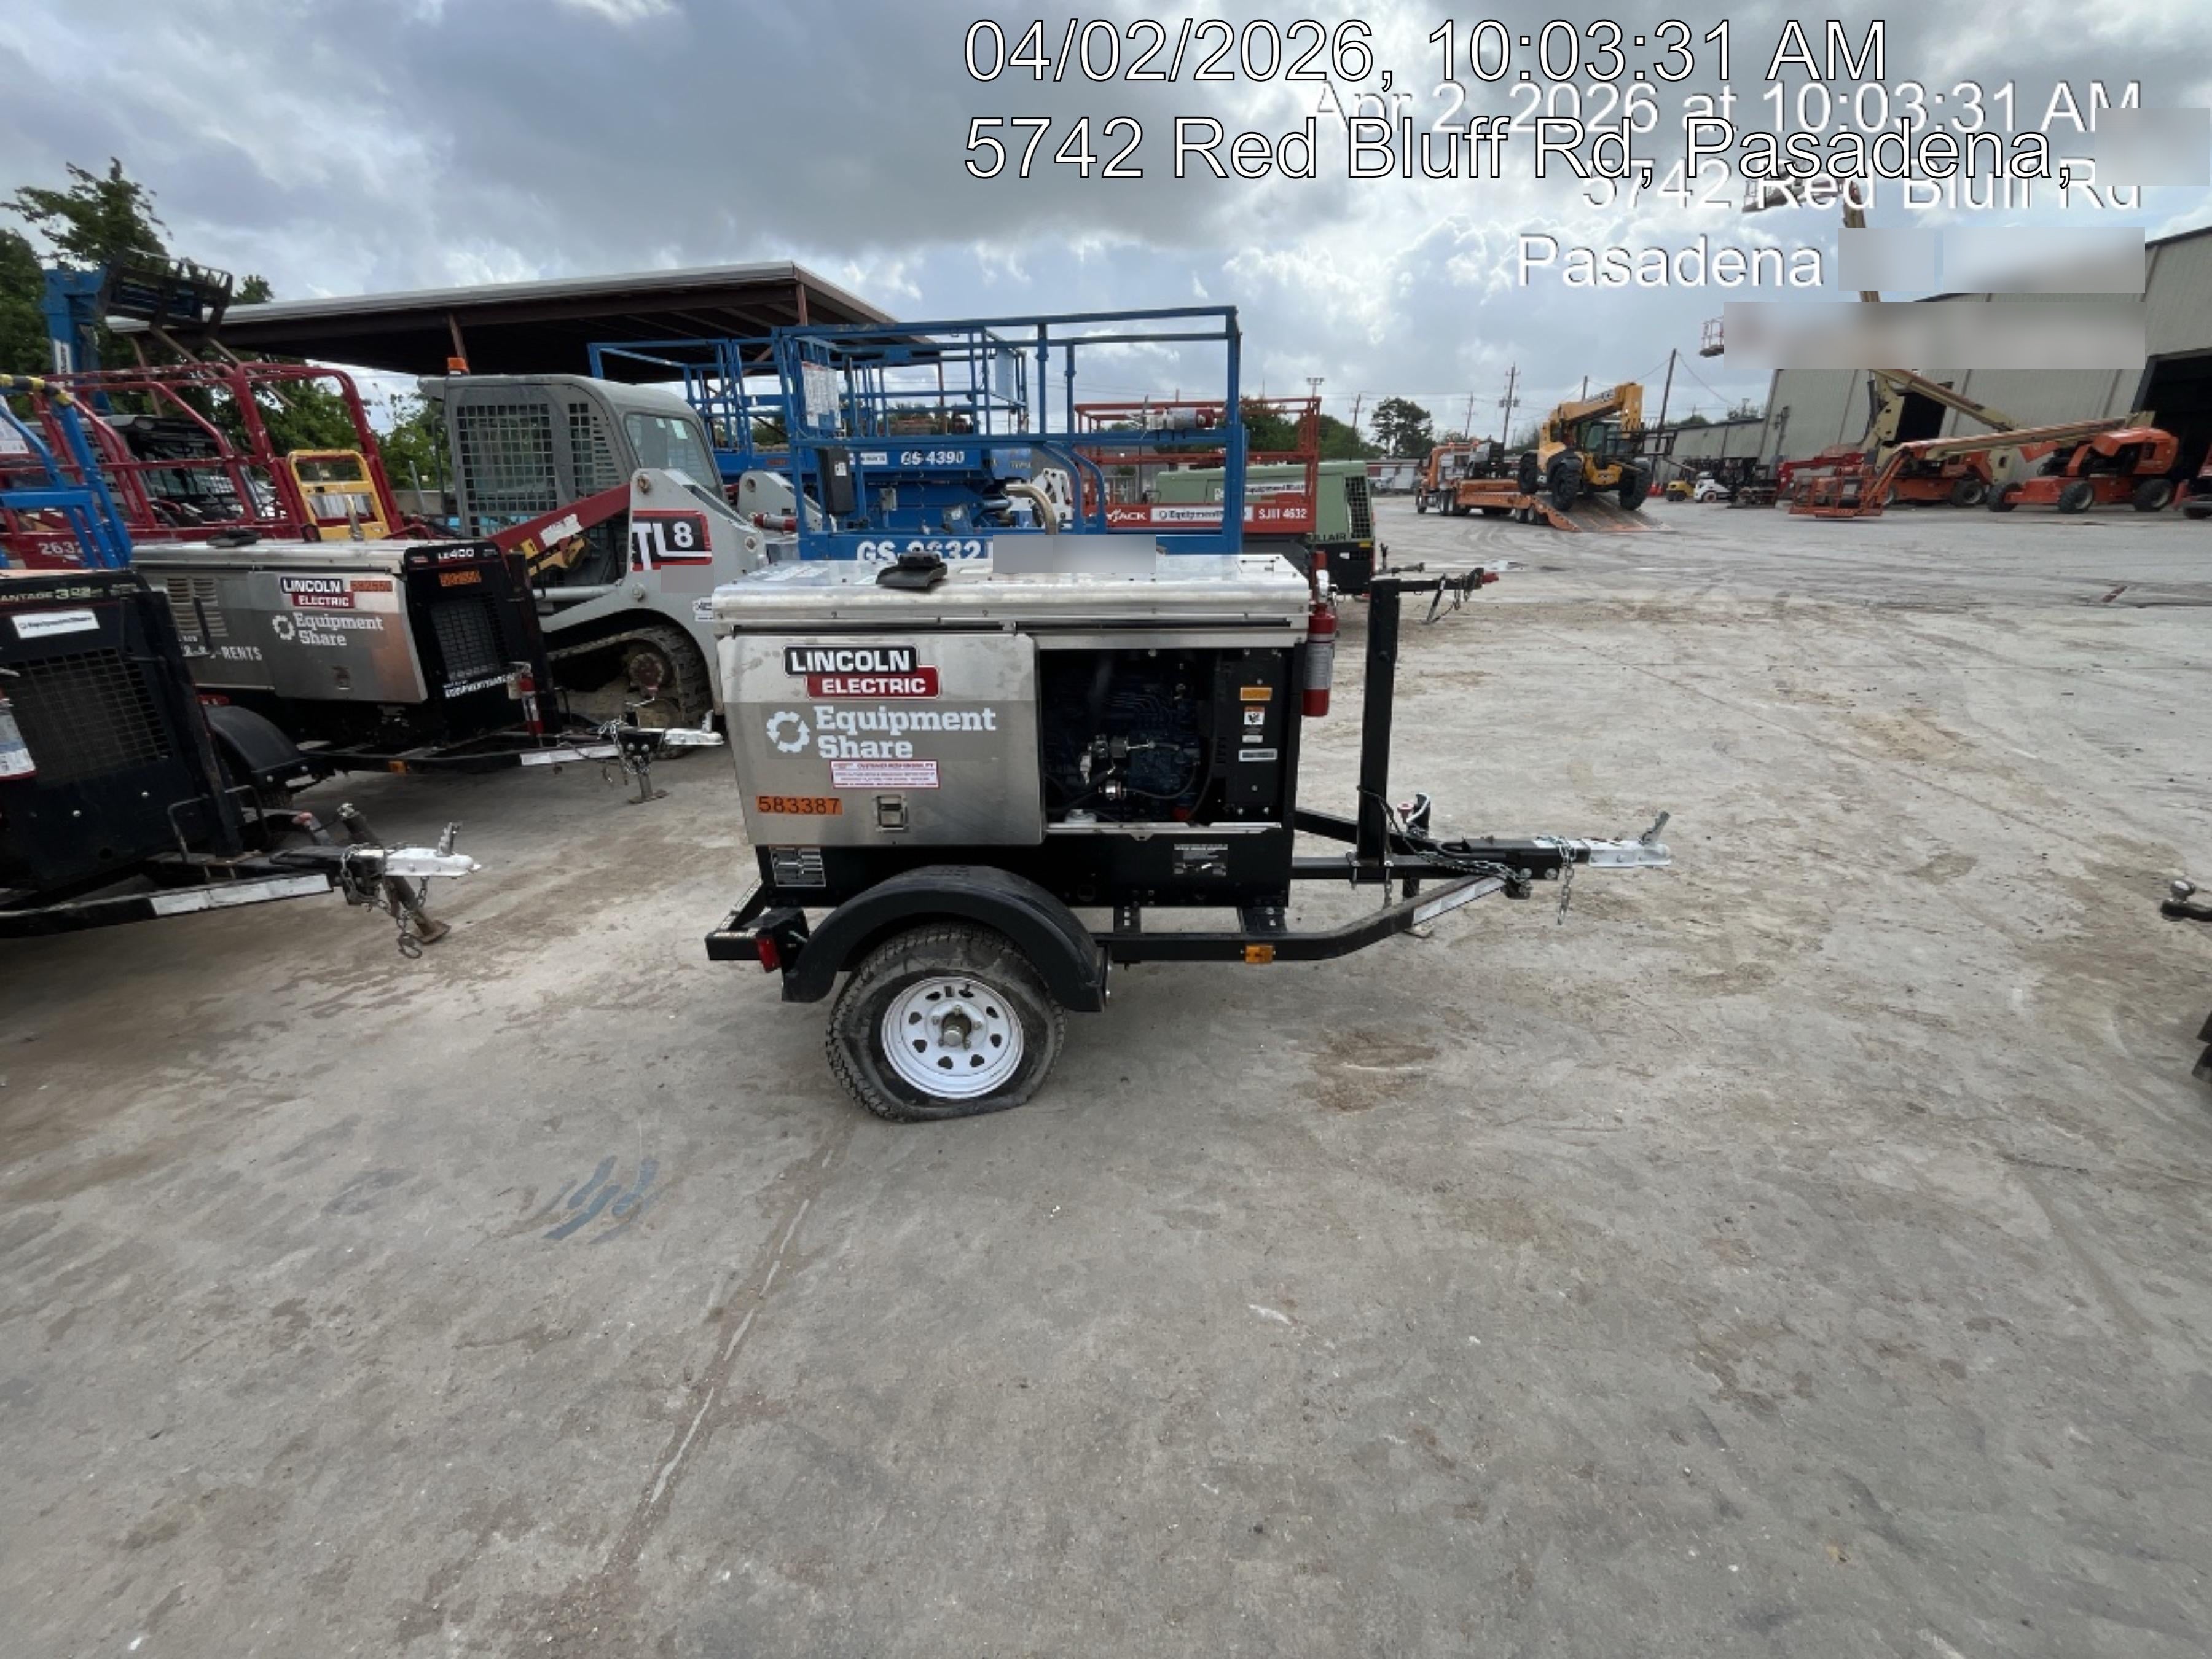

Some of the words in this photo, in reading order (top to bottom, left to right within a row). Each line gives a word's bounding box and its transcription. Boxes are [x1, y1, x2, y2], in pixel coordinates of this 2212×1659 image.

[283, 579, 342, 593] LINCOLN
[298, 595, 350, 607] ELECTRIC
[292, 611, 384, 632] Equipment
[298, 630, 347, 646] Share
[790, 649, 911, 672] LINCOLN
[821, 678, 926, 694] ELECTRIC
[813, 705, 997, 736] Equipment
[817, 735, 914, 758] Share
[759, 796, 841, 815] 583387
